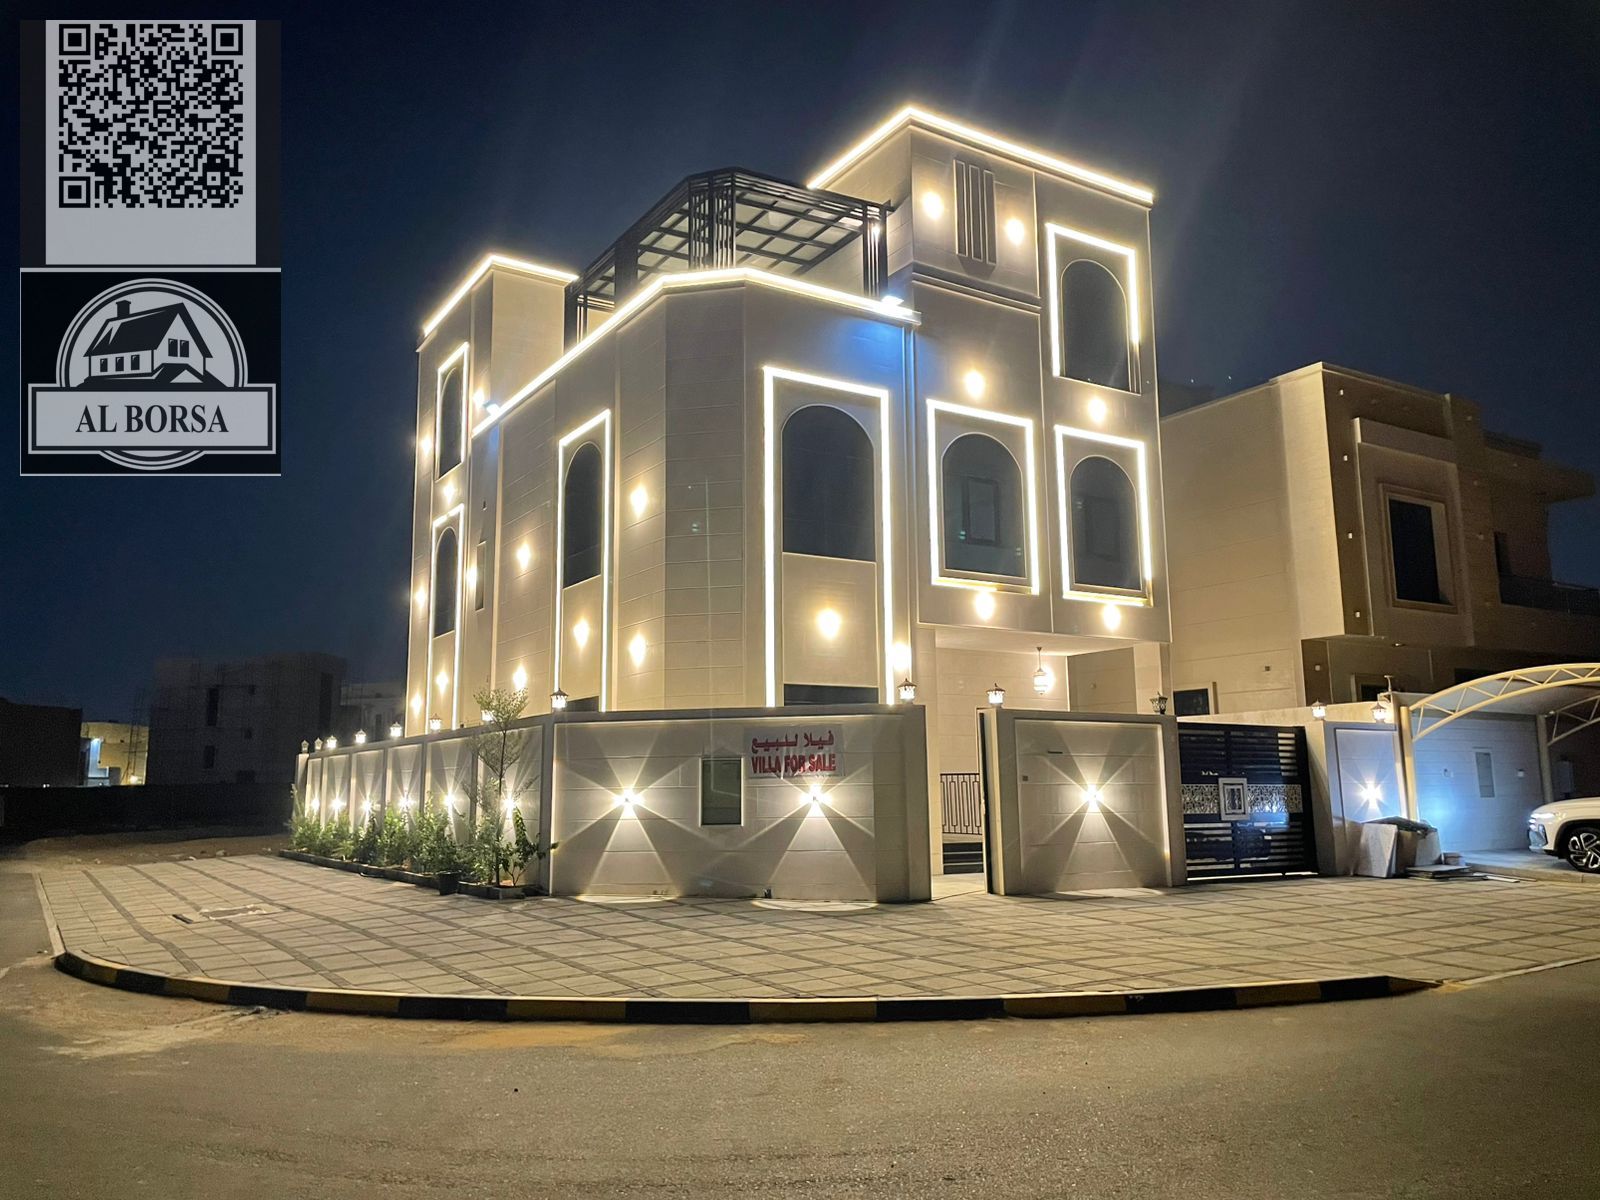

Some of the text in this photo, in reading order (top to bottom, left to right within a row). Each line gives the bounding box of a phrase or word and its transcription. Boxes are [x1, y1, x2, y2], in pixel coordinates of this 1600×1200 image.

[751, 730, 835, 754] فيلا للبيع
[751, 752, 837, 774] VILLA FOR SALE
